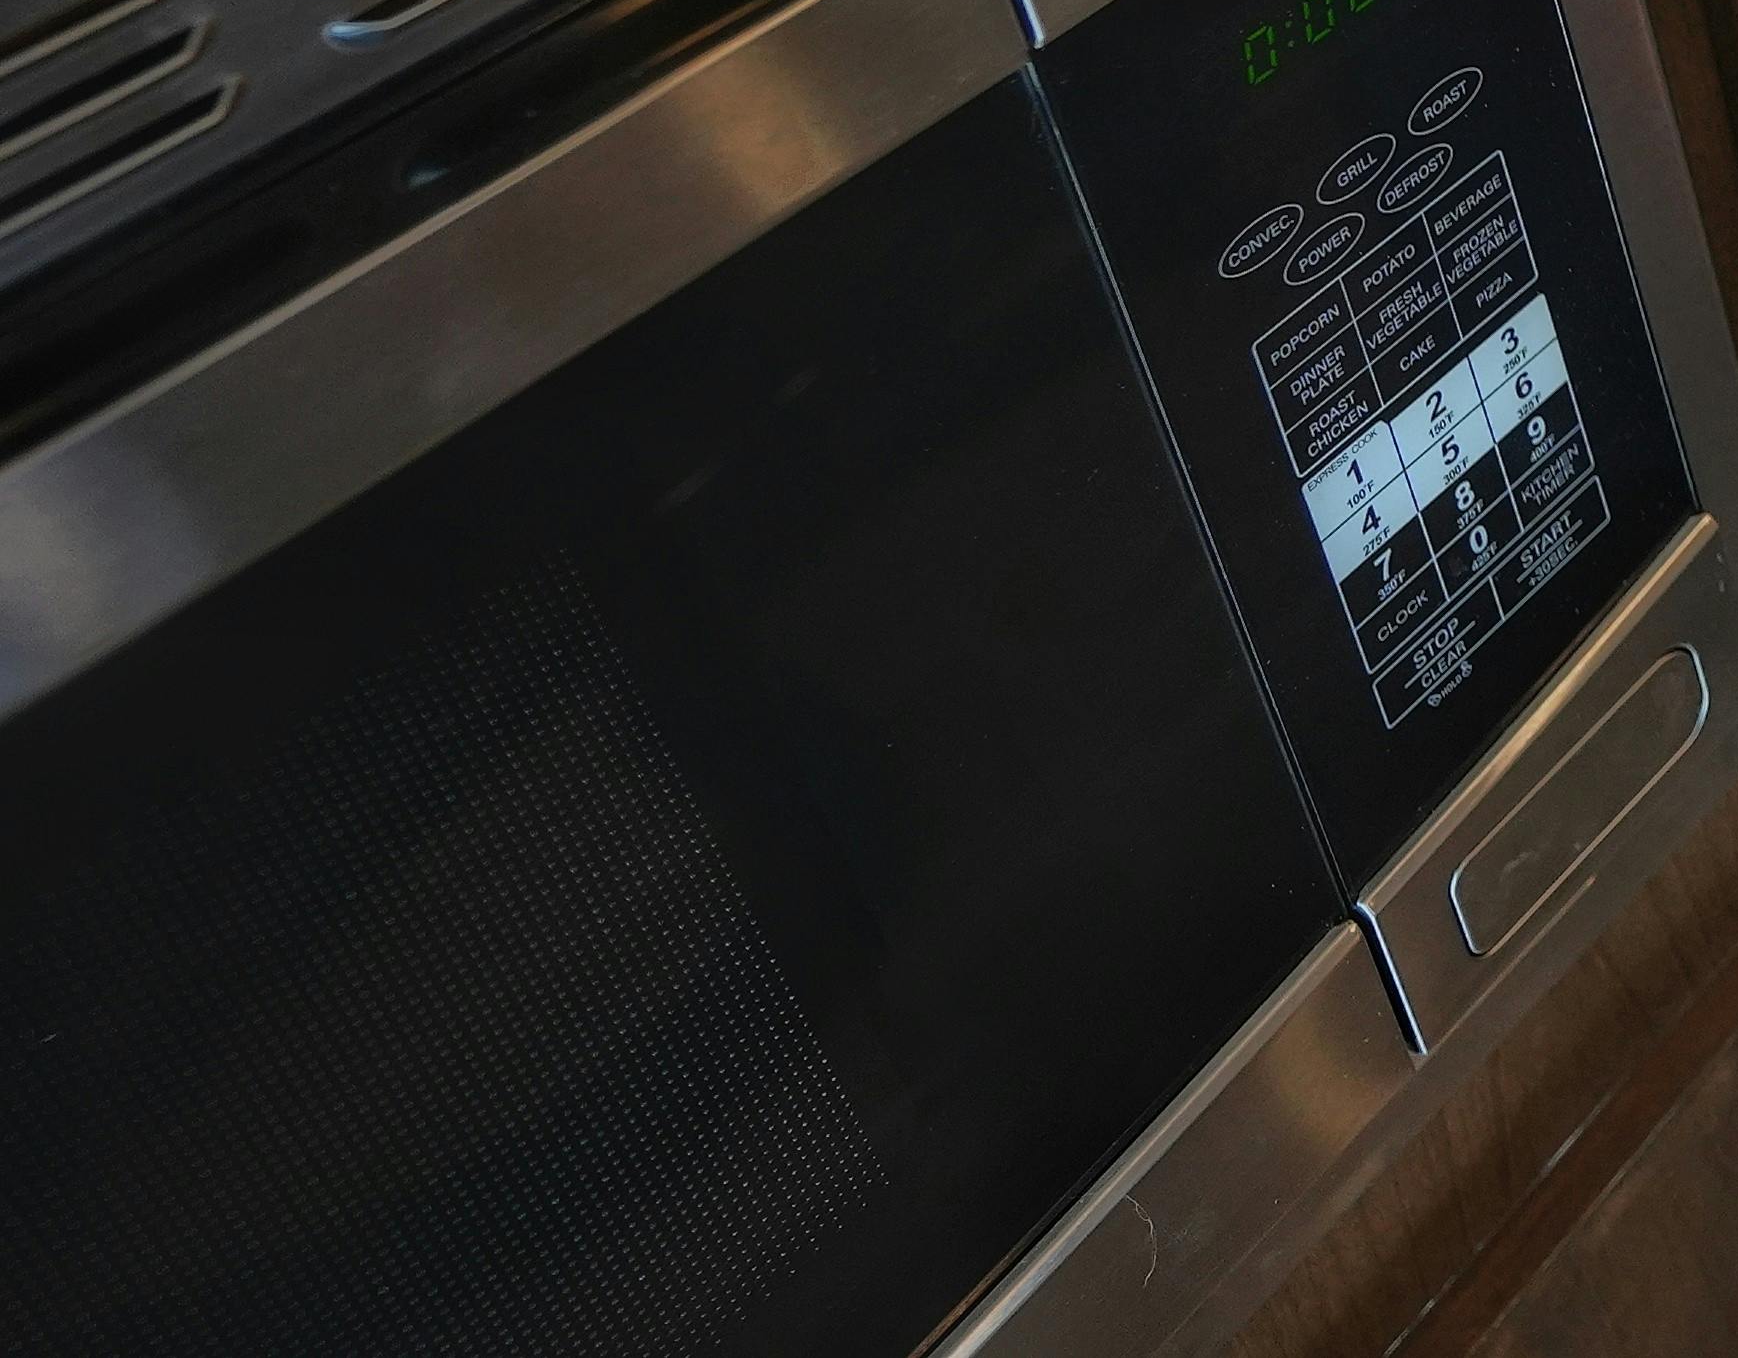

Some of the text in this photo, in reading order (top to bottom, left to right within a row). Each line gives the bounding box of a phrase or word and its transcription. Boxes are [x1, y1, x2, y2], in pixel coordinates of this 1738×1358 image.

[1422, 80, 1468, 122] ROAST
[1337, 152, 1378, 188] GRILL
[1385, 150, 1447, 206] DEFROST
[1434, 173, 1503, 236] BEVERAGE
[1228, 214, 1295, 268] CONVEC.
[1298, 227, 1351, 273] POWER
[1446, 220, 1519, 284] VEGETABLE
[1453, 215, 1505, 263] FROZEN
[1363, 243, 1416, 292] POTATO
[1379, 281, 1423, 324] FRESH
[1476, 272, 1512, 309] PIZZA
[1270, 304, 1340, 366] POPCORN
[1366, 282, 1443, 350] VEGETABLE
[1399, 335, 1436, 371] CAKE
[1500, 327, 1520, 355] 3
[1289, 345, 1346, 397] DINNER
[1301, 364, 1345, 405] PLATE
[1515, 372, 1533, 399] 6
[1309, 390, 1357, 437] ROAST
[1426, 390, 1447, 423] 2
[1307, 400, 1369, 458] CHICKEN
[1441, 435, 1460, 466] 5
[1527, 415, 1546, 445] 9
[1307, 429, 1378, 492] EXPRESS COOK
[1346, 458, 1364, 485] 1
[1521, 443, 1580, 504] KITCHEN
[1455, 480, 1475, 512] 8
[1532, 464, 1575, 506] TIMER
[1361, 505, 1381, 534] 4
[1469, 525, 1489, 555] 0
[1520, 510, 1571, 569] START
[1373, 547, 1393, 582] 7
[1377, 589, 1430, 642] CLOCK
[1413, 617, 1458, 669] STOP
[1421, 640, 1467, 688] CLEAR
[1441, 674, 1463, 698] HOLD
